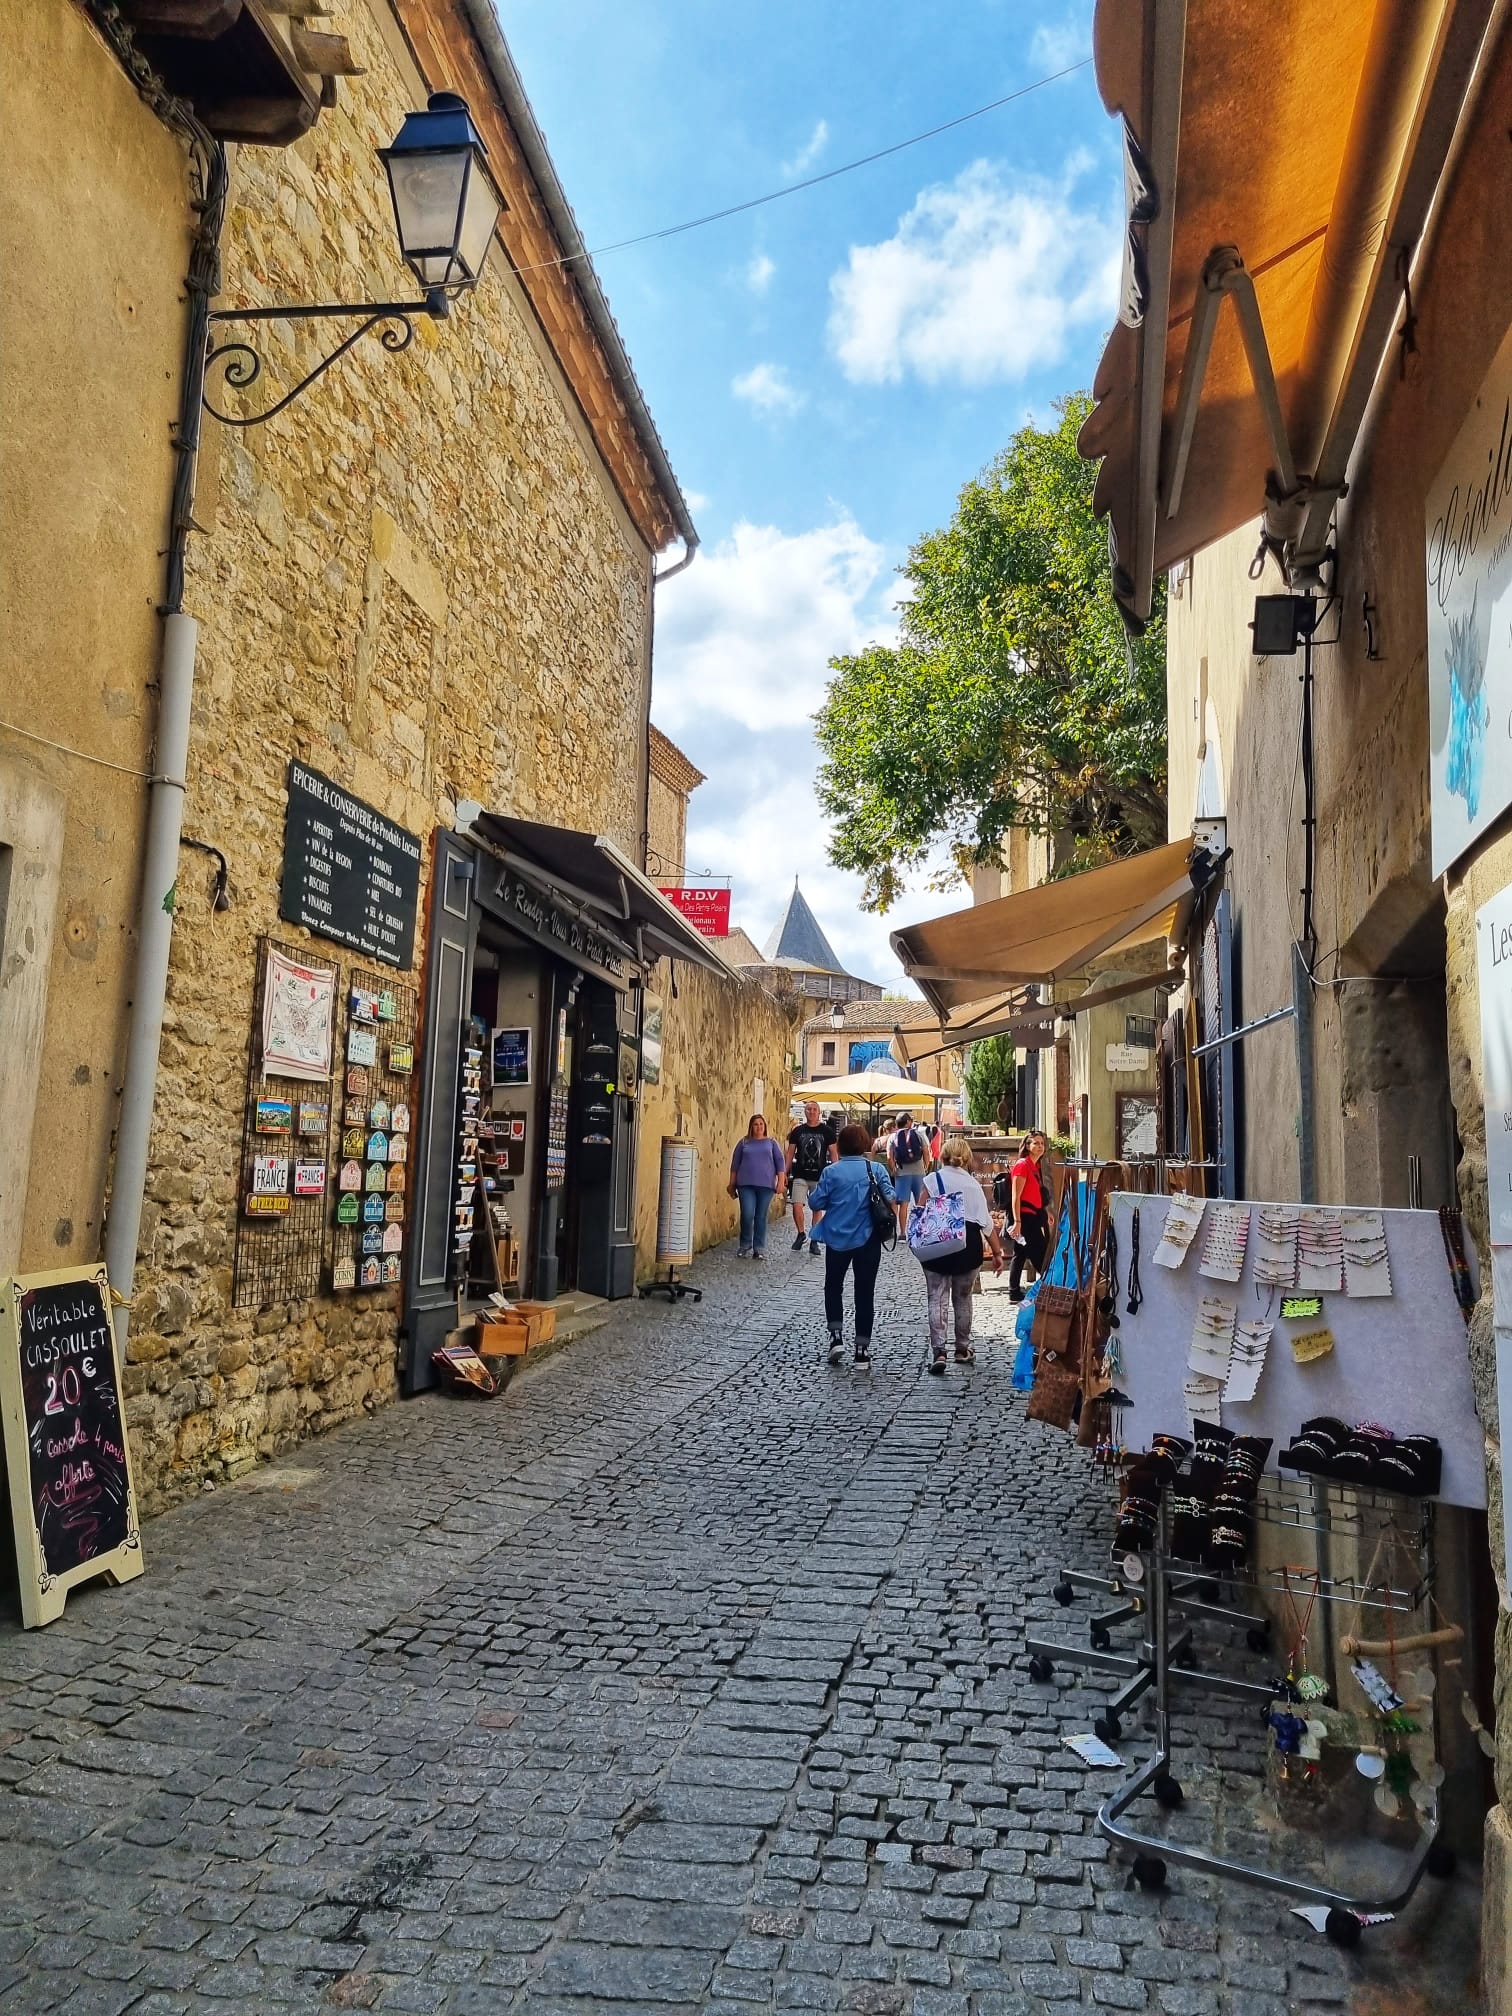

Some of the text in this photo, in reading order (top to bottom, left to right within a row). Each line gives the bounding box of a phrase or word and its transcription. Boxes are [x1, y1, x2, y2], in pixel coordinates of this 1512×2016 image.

[293, 766, 419, 859] EPICERIE & CONSERVERIE de Produits Locaux
[311, 838, 353, 870] VIN de la REGION
[309, 855, 332, 877] DIGESTIFS
[308, 874, 330, 895] BISCUITS
[307, 893, 332, 915] VINAIGRES
[496, 870, 510, 901] Le
[514, 882, 567, 942] Rendez-Vous
[681, 891, 719, 901] R.D.V
[378, 908, 384, 922] de
[301, 911, 400, 963] Venez Composer Votre Panier Gourmand
[367, 923, 379, 938] HUILE
[256, 1168, 286, 1188] FRANCE
[301, 1169, 320, 1184] FRANCE
[28, 1300, 96, 1333] Véritable
[26, 1327, 107, 1368] CASSOULET
[45, 1357, 97, 1416] 20 €
